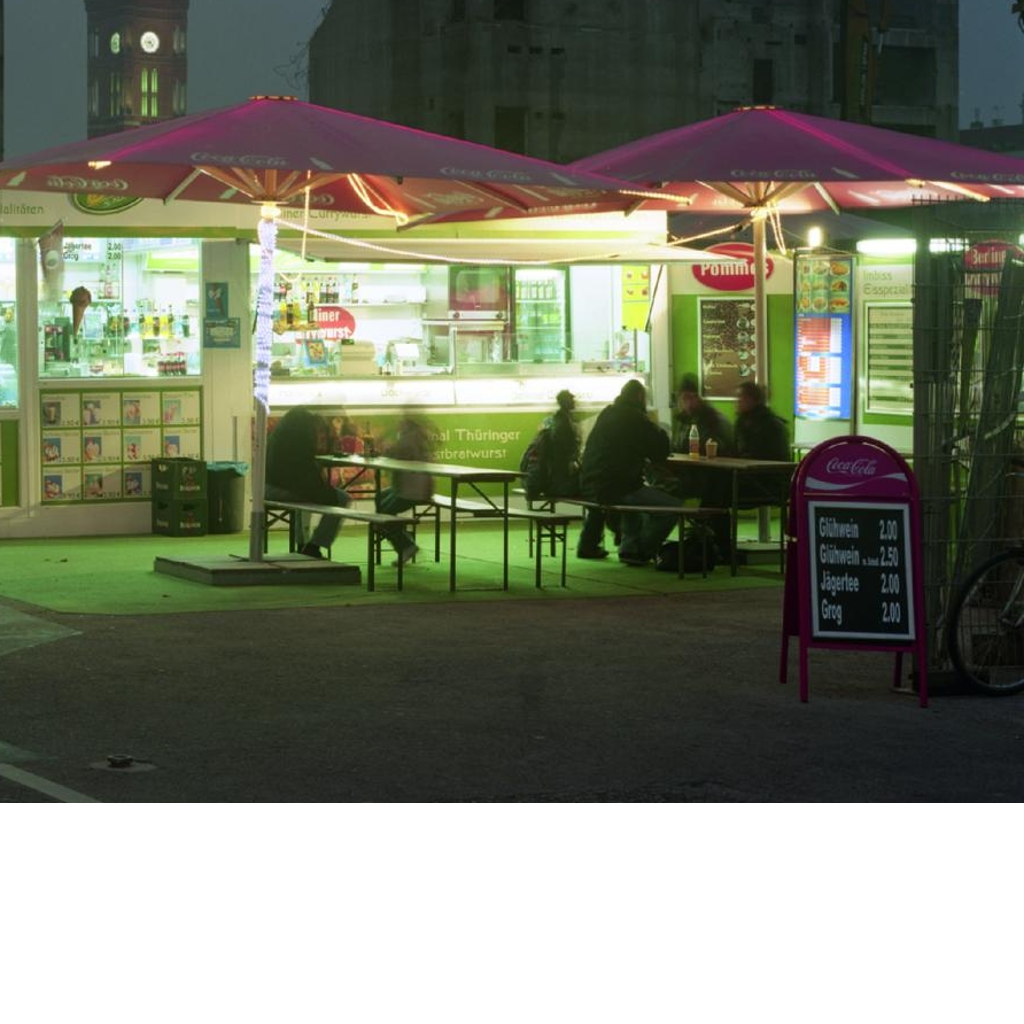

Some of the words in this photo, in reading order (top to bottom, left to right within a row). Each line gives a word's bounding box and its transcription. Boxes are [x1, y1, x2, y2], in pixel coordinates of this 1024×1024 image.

[454, 428, 521, 443] Thüringer
[432, 448, 507, 461] stbratwurst
[826, 456, 877, 476] Coca-Cola
[819, 516, 859, 539] Glühwein
[879, 519, 898, 540] 2.00
[819, 543, 860, 565] Glühwein
[880, 547, 899, 567] 2.50
[820, 570, 860, 596] Jägertee
[881, 574, 900, 595] 2.00
[821, 598, 842, 625] Grog
[882, 602, 901, 623] 2.00
